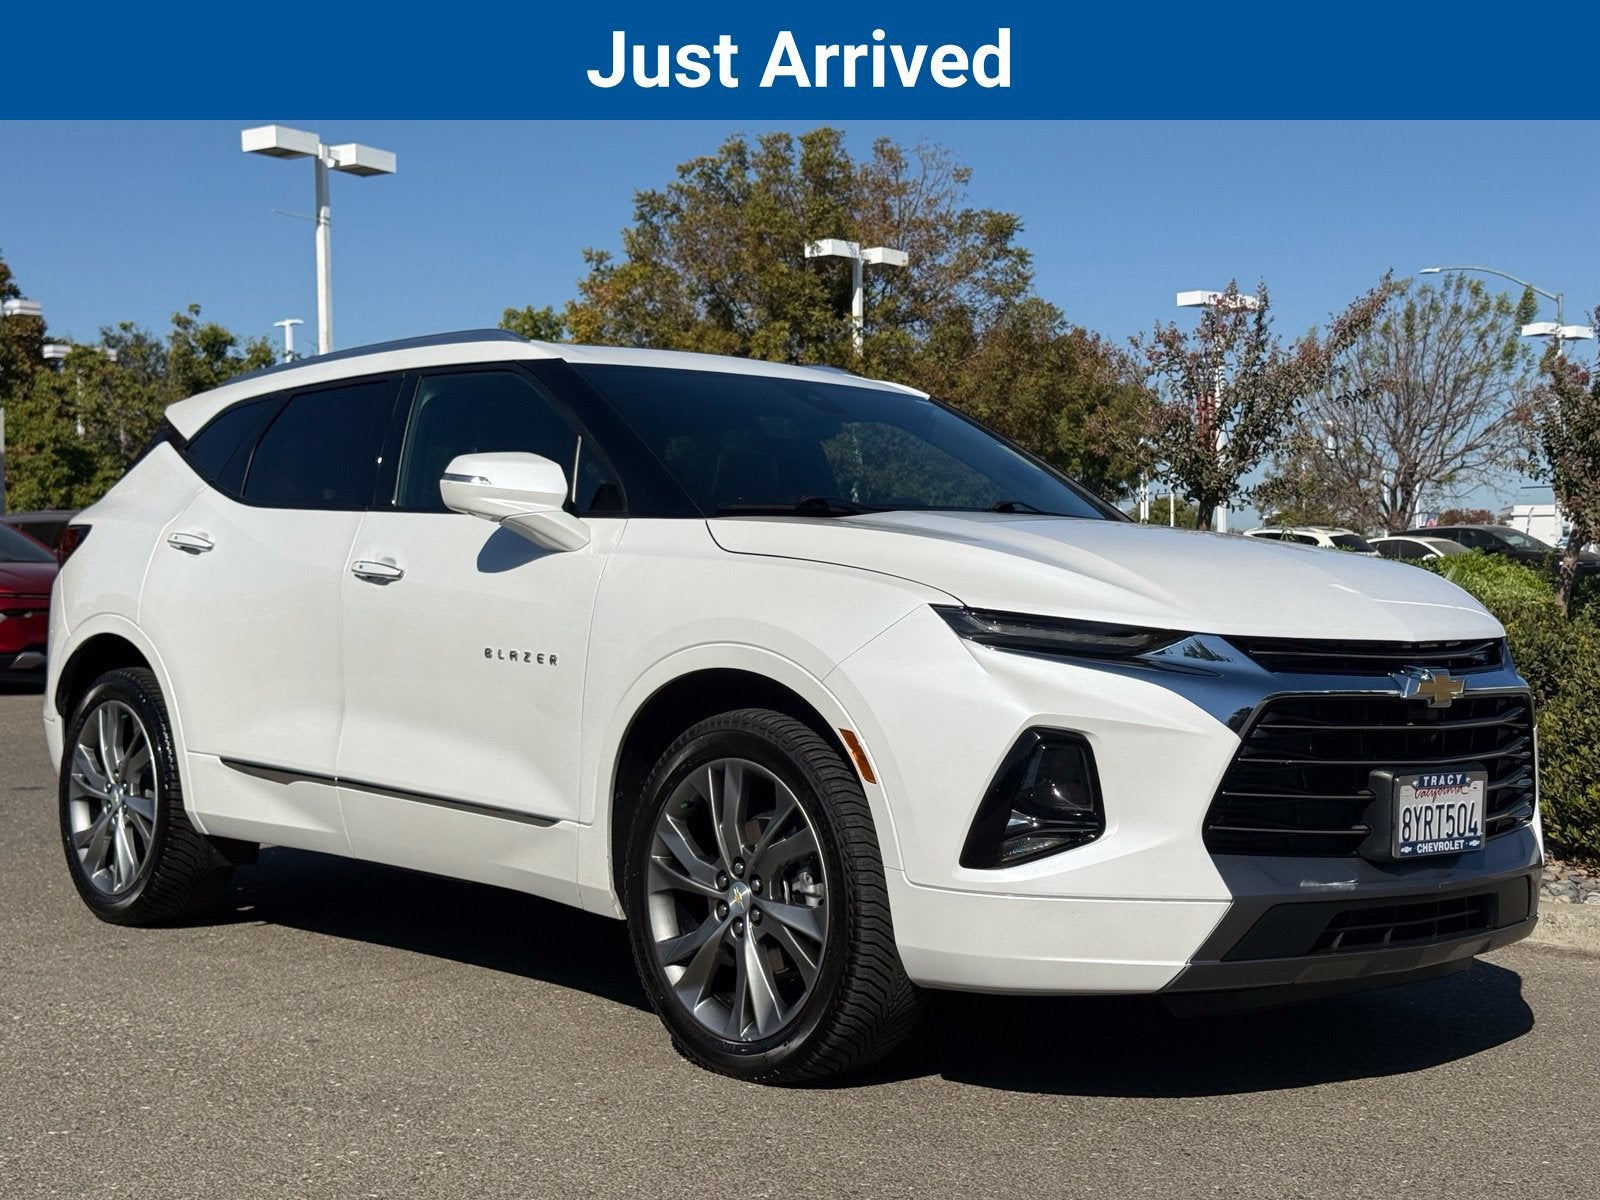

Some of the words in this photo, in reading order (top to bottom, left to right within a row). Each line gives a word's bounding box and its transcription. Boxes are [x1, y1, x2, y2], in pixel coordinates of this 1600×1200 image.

[484, 647, 558, 666] BLAZER
[1423, 774, 1463, 786] TRACY
[1401, 802, 1478, 842] 8YRT504
[1416, 839, 1465, 854] CHEVROLET
